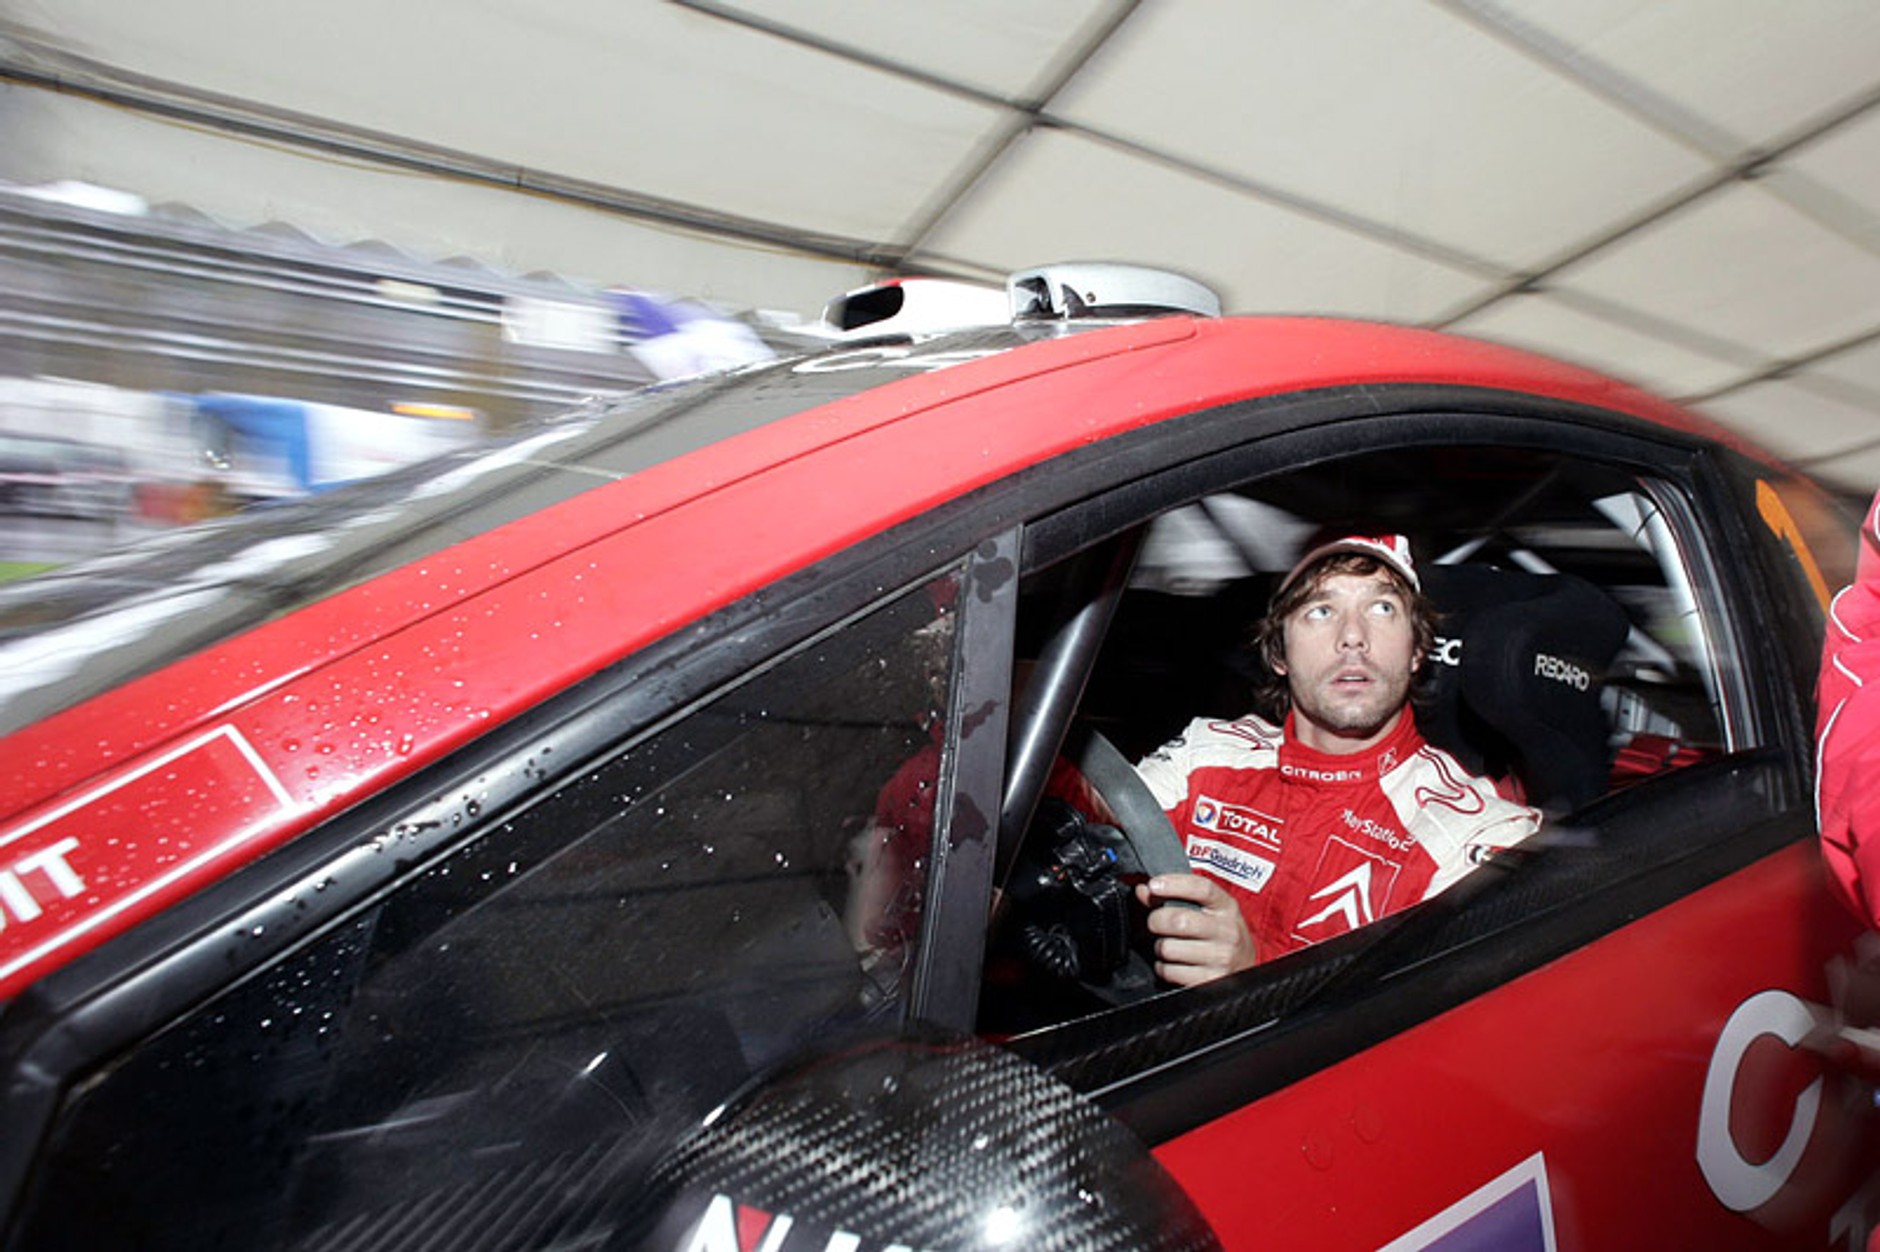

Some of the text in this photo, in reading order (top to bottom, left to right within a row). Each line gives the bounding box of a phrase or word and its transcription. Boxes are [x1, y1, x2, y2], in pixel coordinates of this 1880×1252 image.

[1534, 652, 1590, 692] RECARO
[1221, 809, 1282, 845] TOTAL
[0, 836, 87, 935] IT
